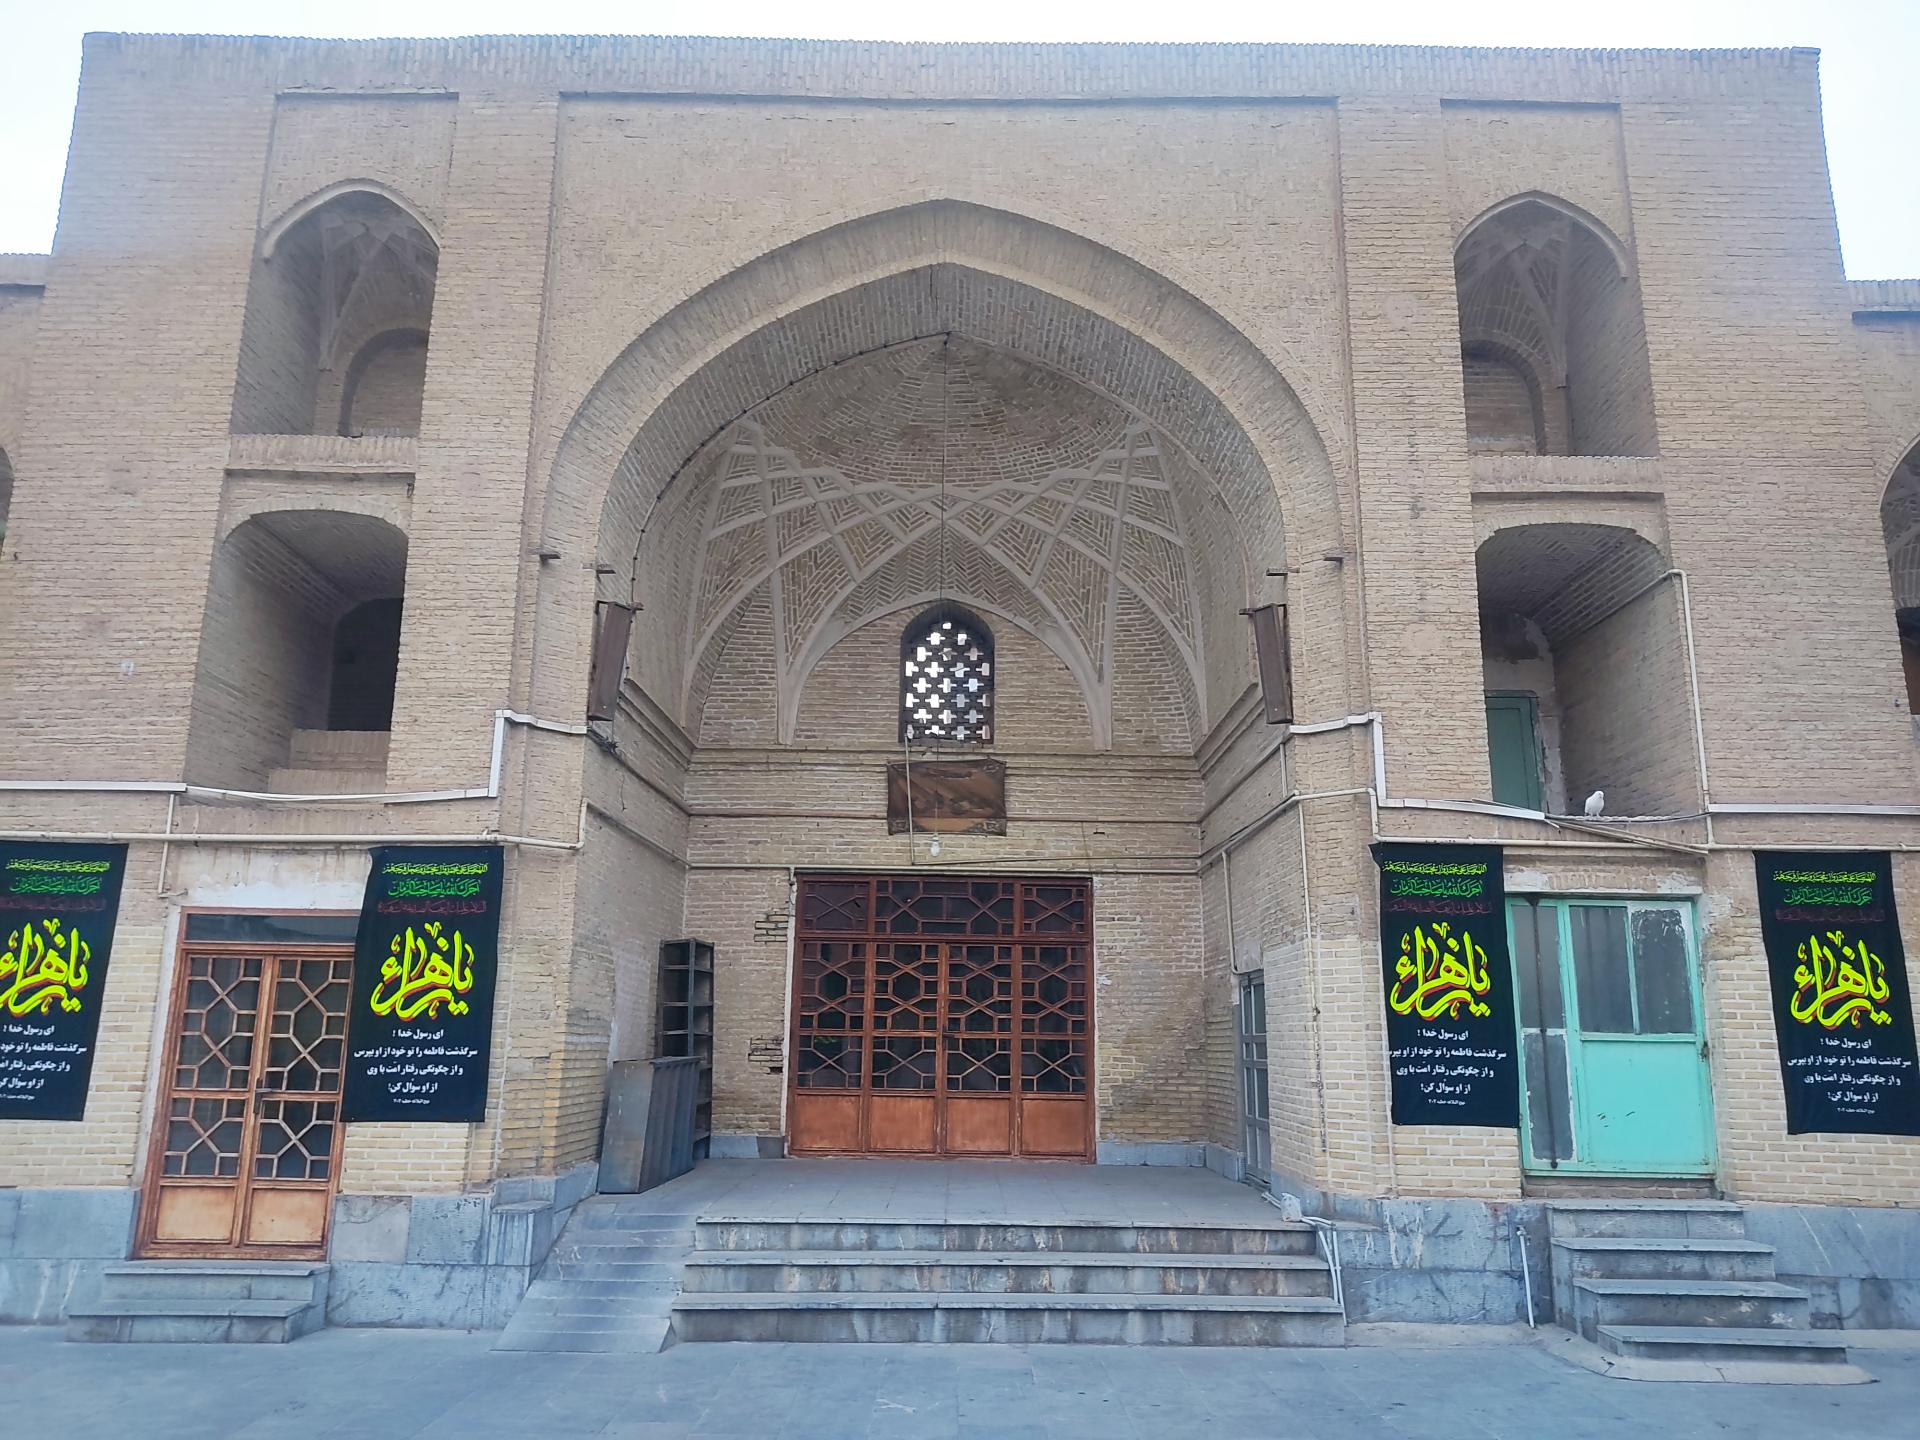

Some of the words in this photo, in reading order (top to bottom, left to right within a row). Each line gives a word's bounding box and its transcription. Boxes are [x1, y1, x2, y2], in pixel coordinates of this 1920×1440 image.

[8, 1024, 22, 1032] خدا
[23, 1025, 42, 1035] رسول
[44, 1026, 54, 1035] ای
[398, 1028, 412, 1037] خدا
[1422, 1028, 1437, 1036] خدا
[413, 1029, 432, 1040] رسول
[432, 1030, 444, 1039] ای
[1438, 1029, 1458, 1040] رسول
[1458, 1030, 1468, 1040] ای
[16, 1042, 24, 1052] تو
[26, 1042, 32, 1052] را
[32, 1042, 54, 1050] فاطمه
[1826, 1038, 1840, 1046] خدا
[1841, 1038, 1860, 1048] رسول
[1862, 1039, 1872, 1048] ای
[54, 1044, 87, 1054] سرگذشت
[374, 1047, 382, 1056] او
[382, 1047, 390, 1057] از
[391, 1046, 406, 1056] خود
[407, 1047, 414, 1056] تو
[416, 1047, 422, 1056] را
[423, 1046, 444, 1054] فاطمه
[445, 1048, 478, 1057] سرگذشت
[1402, 1047, 1410, 1057] او
[1410, 1047, 1417, 1057] از
[1418, 1046, 1434, 1057] خود
[1434, 1047, 1442, 1057] تو
[1444, 1047, 1450, 1057] را
[1451, 1048, 1472, 1056] فاطمه
[1473, 1049, 1506, 1060] سرگذشت
[8, 1059, 26, 1070] رفتار
[1808, 1055, 1814, 1065] او
[1815, 1056, 1822, 1066] از
[1824, 1056, 1838, 1066] خود
[1840, 1056, 1846, 1066] تو
[1848, 1056, 1855, 1066] را
[1856, 1056, 1877, 1064] فاطمه
[1878, 1057, 1912, 1068] سرگذشت
[27, 1060, 56, 1071] چگونگی
[57, 1062, 65, 1072] از
[65, 1064, 70, 1072] و
[380, 1065, 385, 1074] با
[401, 1064, 418, 1075] رفتار
[419, 1064, 449, 1075] چگونگی
[450, 1065, 458, 1075] از
[458, 1066, 464, 1075] و
[1409, 1065, 1414, 1075] با
[1432, 1064, 1449, 1075] رفتار
[367, 1067, 378, 1075] وی
[1396, 1068, 1408, 1076] وی
[1450, 1066, 1480, 1077] چگونگی
[1481, 1066, 1488, 1077] از
[1804, 1075, 1814, 1083] وی
[1815, 1072, 1821, 1082] با
[1839, 1073, 1856, 1084] رفتار
[1856, 1074, 1886, 1085] چگونگی
[1888, 1075, 1895, 1086] از
[1896, 1077, 1901, 1086] و
[27, 1079, 35, 1088] او
[35, 1079, 44, 1088] از
[421, 1082, 429, 1092] او
[430, 1082, 438, 1092] از
[1455, 1083, 1462, 1094] او
[1464, 1083, 1471, 1094] از
[1864, 1092, 1870, 1102] او
[1872, 1093, 1878, 1102] از
